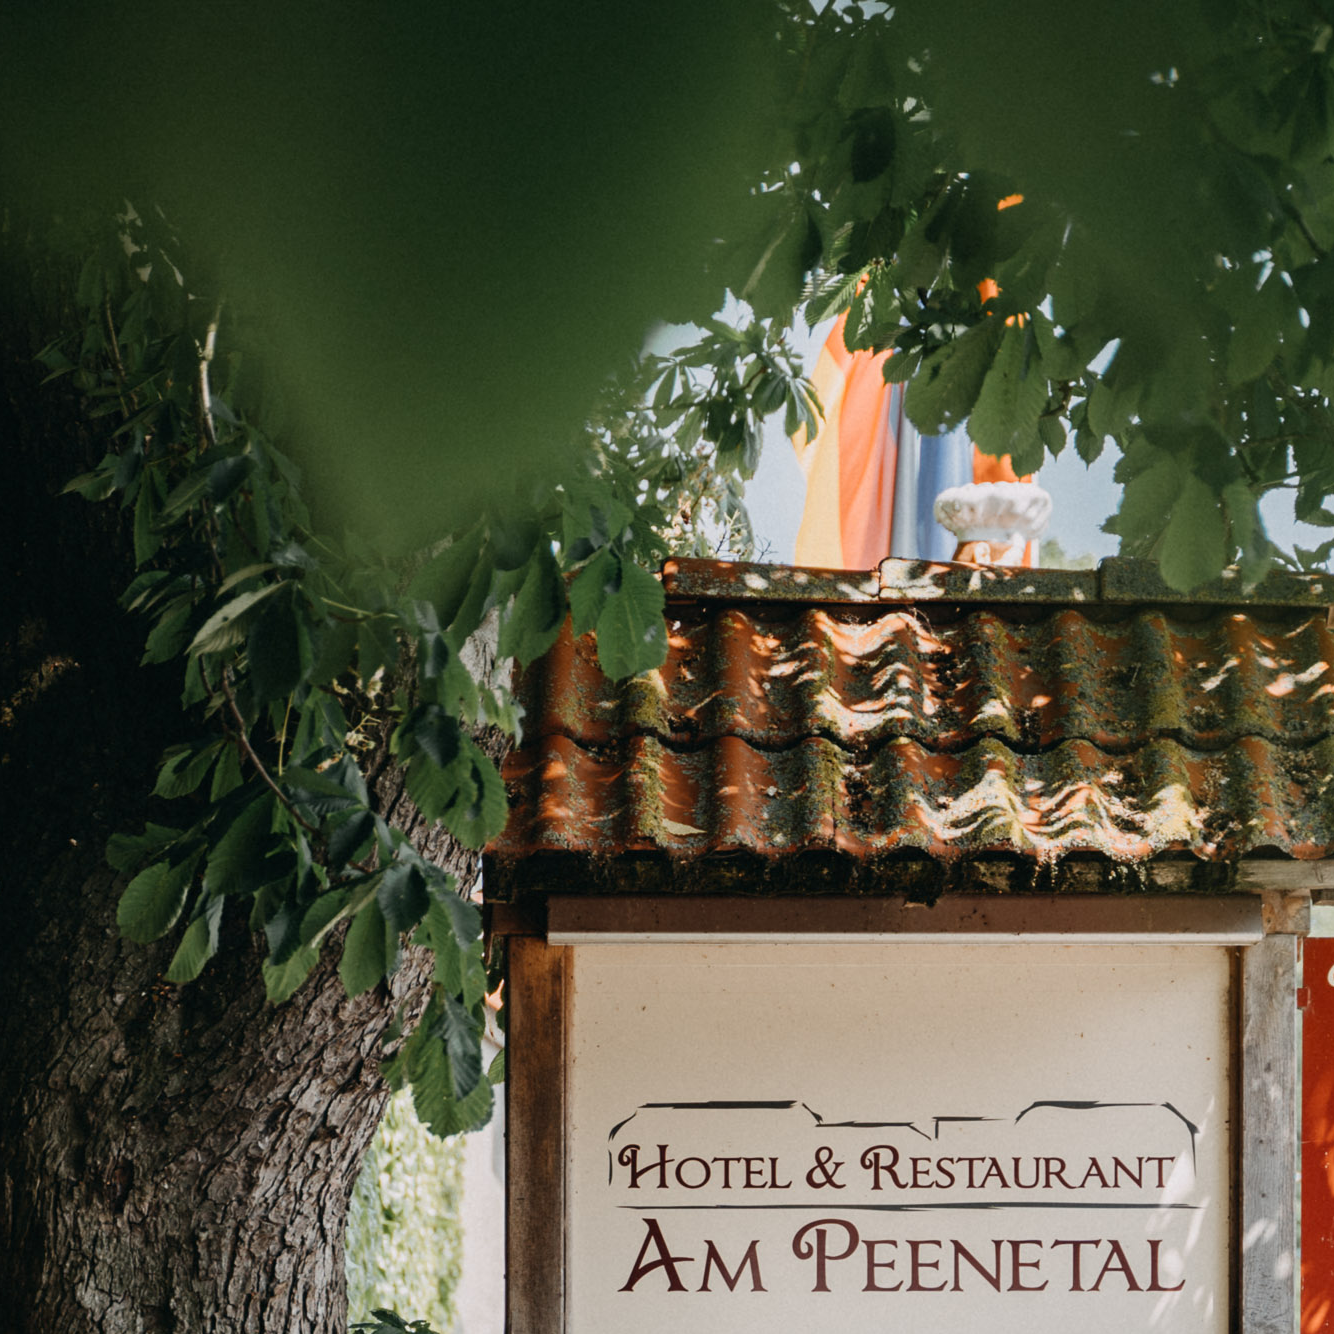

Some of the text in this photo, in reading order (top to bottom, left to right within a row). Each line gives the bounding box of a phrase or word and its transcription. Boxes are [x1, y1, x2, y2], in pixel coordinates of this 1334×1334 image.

[616, 1142, 1177, 1191] HOTEL & RESTAURANT
[616, 1216, 1187, 1294] AM PEENETAL
